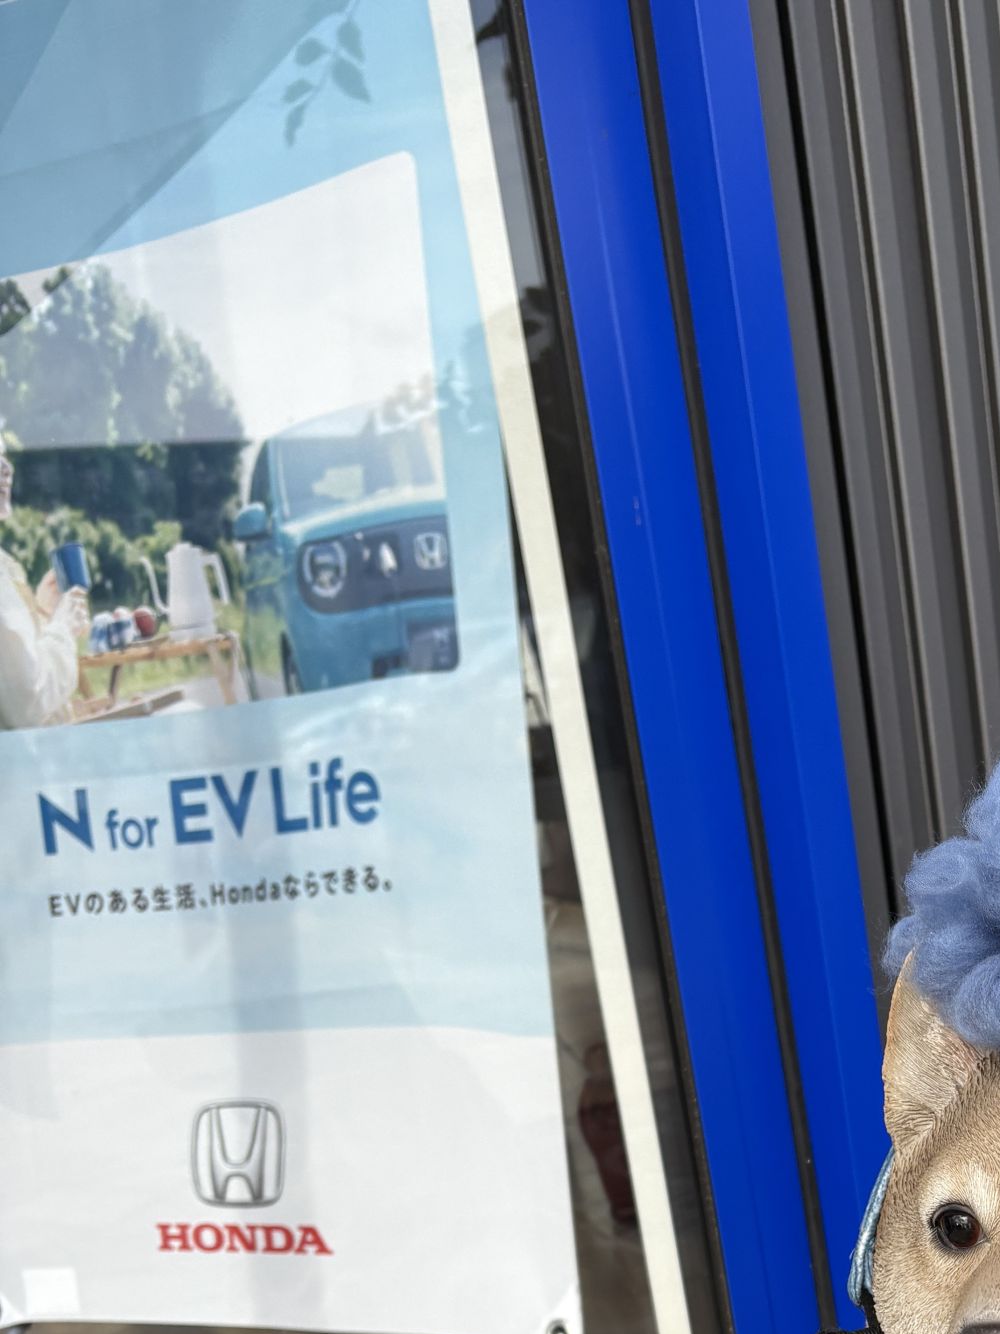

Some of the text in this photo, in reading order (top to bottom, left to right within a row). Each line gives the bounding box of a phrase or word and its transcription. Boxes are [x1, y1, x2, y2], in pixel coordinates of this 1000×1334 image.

[37, 757, 380, 855] N for EV Life
[156, 1222, 334, 1256] HONDA
